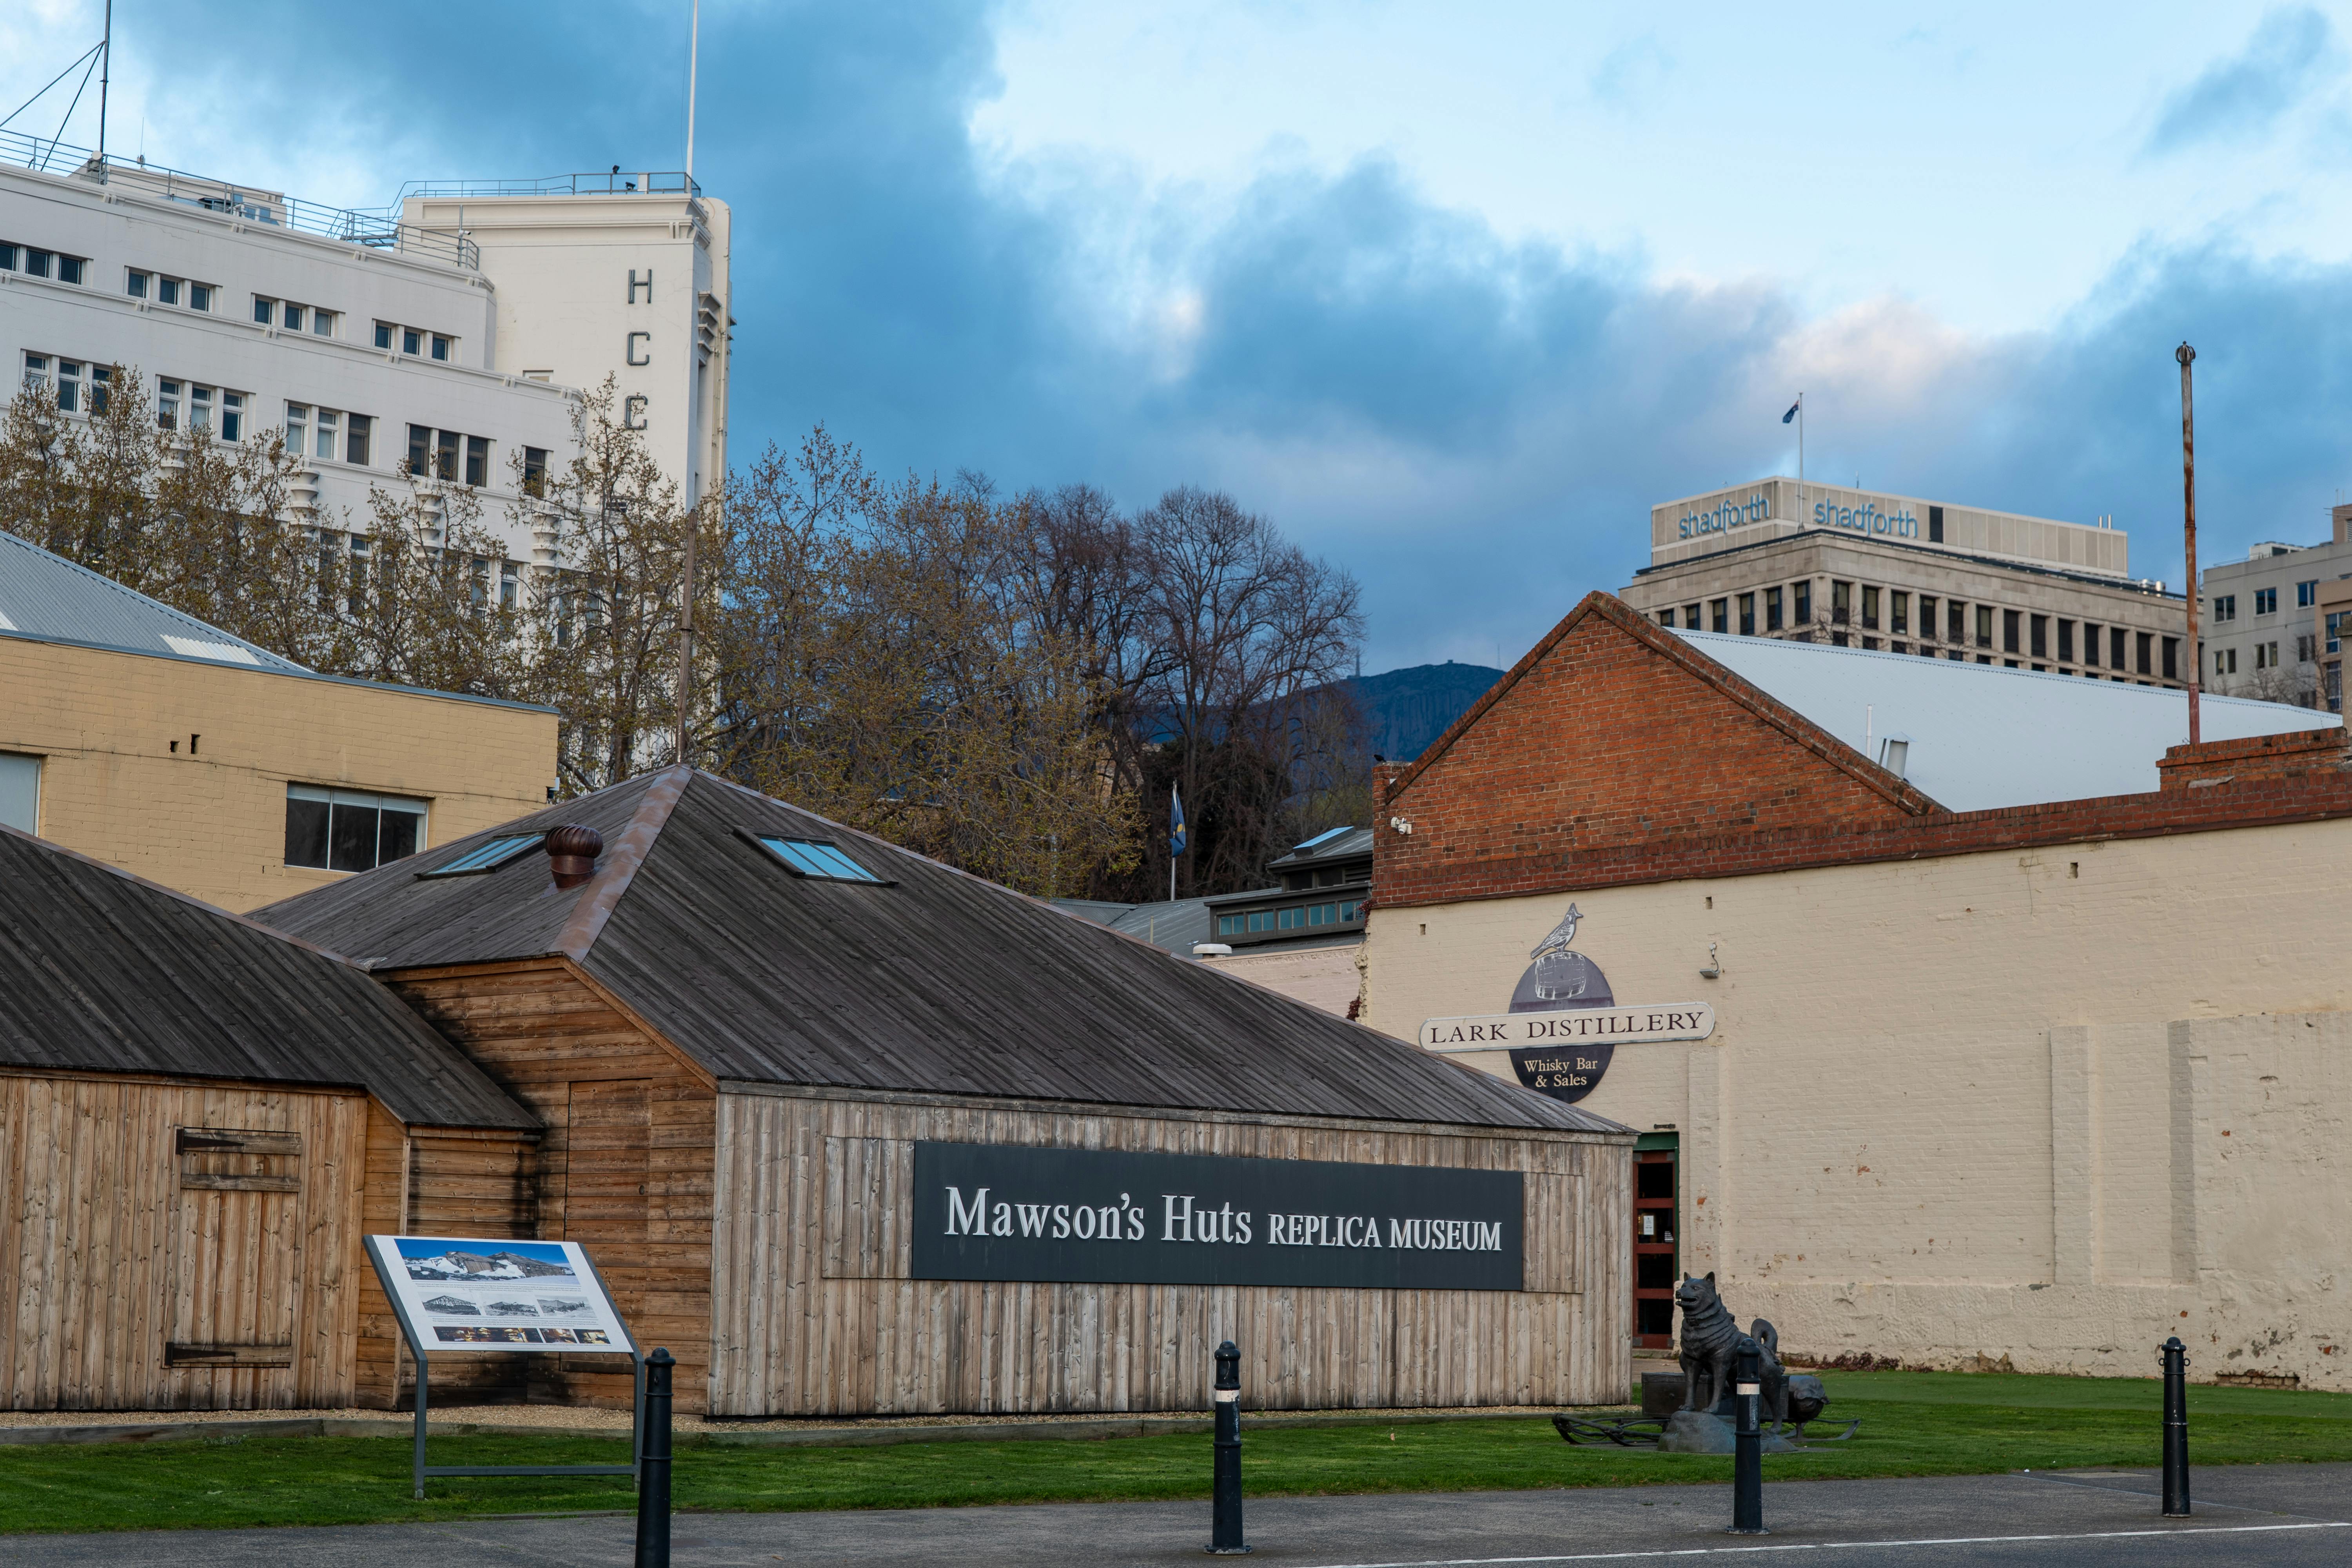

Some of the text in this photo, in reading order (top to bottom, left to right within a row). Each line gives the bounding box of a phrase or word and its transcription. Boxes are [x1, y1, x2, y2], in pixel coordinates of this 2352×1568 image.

[1679, 494, 1769, 538] shadforth
[1814, 498, 1918, 537] shadforth
[1430, 1011, 1704, 1044] LARK DISTILLERY
[1524, 1058, 1598, 1073] Whisky Bar
[1535, 1074, 1587, 1087] & Sales
[944, 1187, 1502, 1250] Mawson's Huts REPLICA MUSEUM
